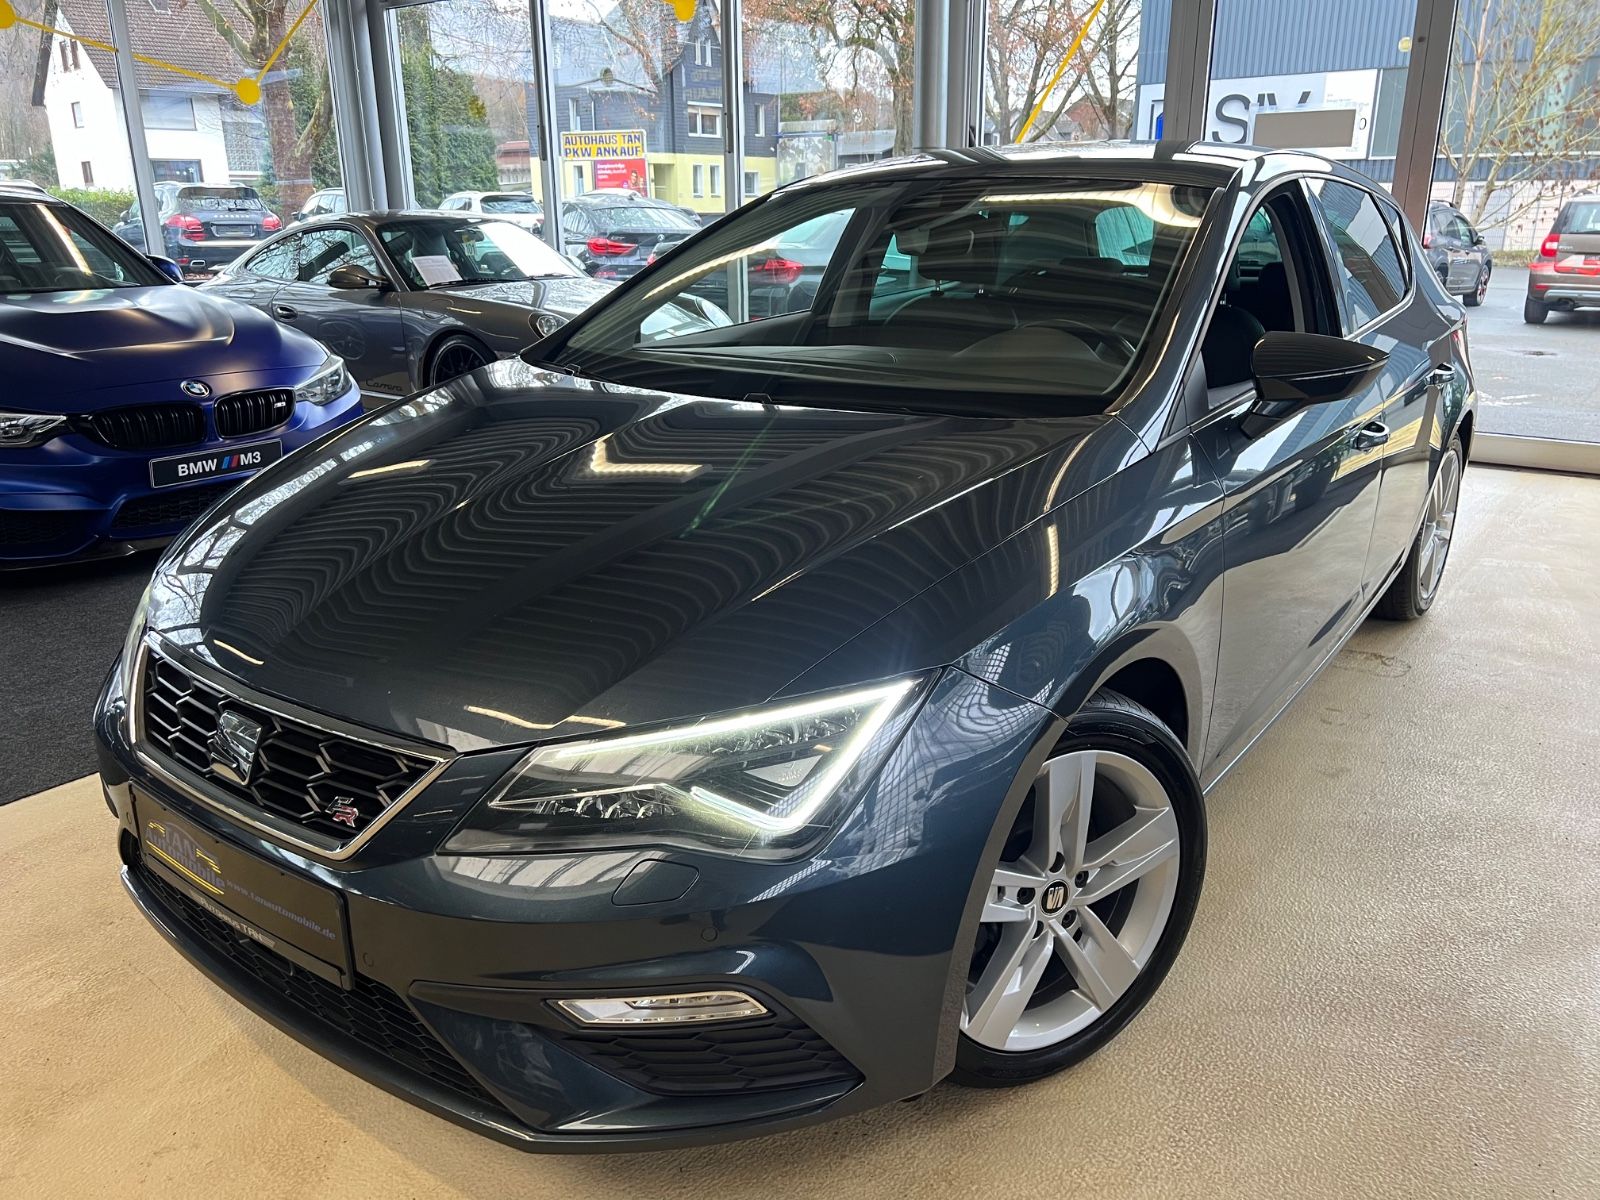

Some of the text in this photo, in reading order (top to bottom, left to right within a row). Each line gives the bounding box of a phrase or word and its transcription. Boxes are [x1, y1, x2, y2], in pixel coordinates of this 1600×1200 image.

[564, 134, 640, 145] AUTOHAUS TAN
[565, 146, 641, 157] PKW ANKAUF
[177, 451, 262, 477] BMW M3
[324, 795, 359, 828] FR
[144, 827, 226, 891] Automobile
[225, 878, 337, 941] www.tanautomobile.de
